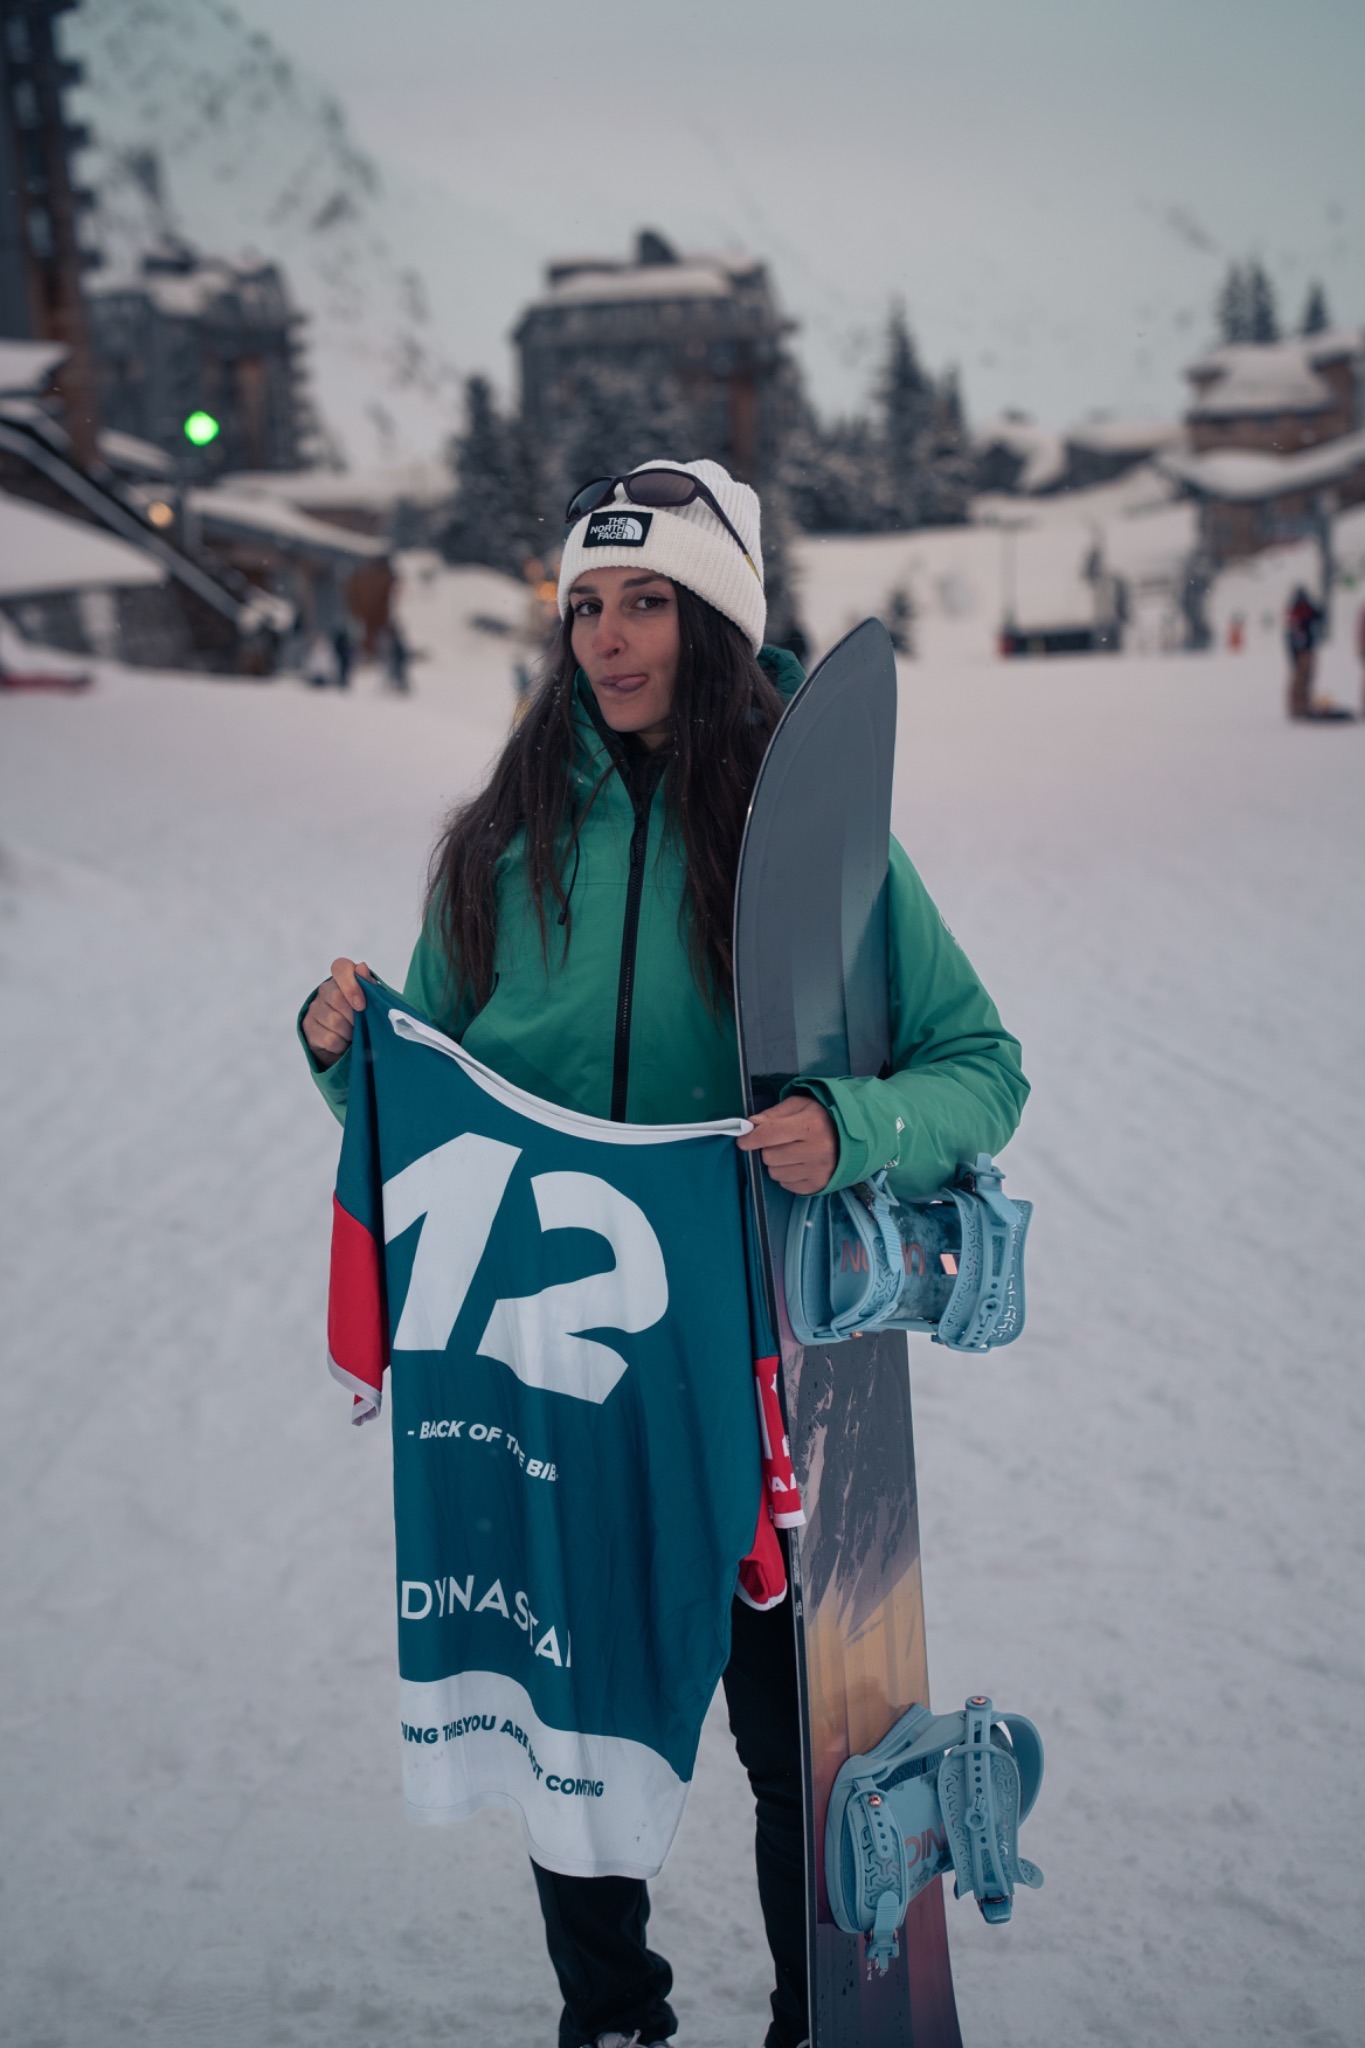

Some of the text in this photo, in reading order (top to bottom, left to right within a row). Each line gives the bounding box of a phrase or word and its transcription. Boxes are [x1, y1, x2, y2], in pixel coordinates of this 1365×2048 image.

[608, 517, 627, 525] THE
[590, 525, 625, 534] NORTH
[597, 532, 624, 540] FACE
[382, 1131, 669, 1405] 12
[419, 1420, 466, 1440] BACK
[468, 1423, 503, 1443] OF
[401, 1720, 439, 1744] ING
[462, 1714, 497, 1734] YOU
[499, 1719, 530, 1750] ARE
